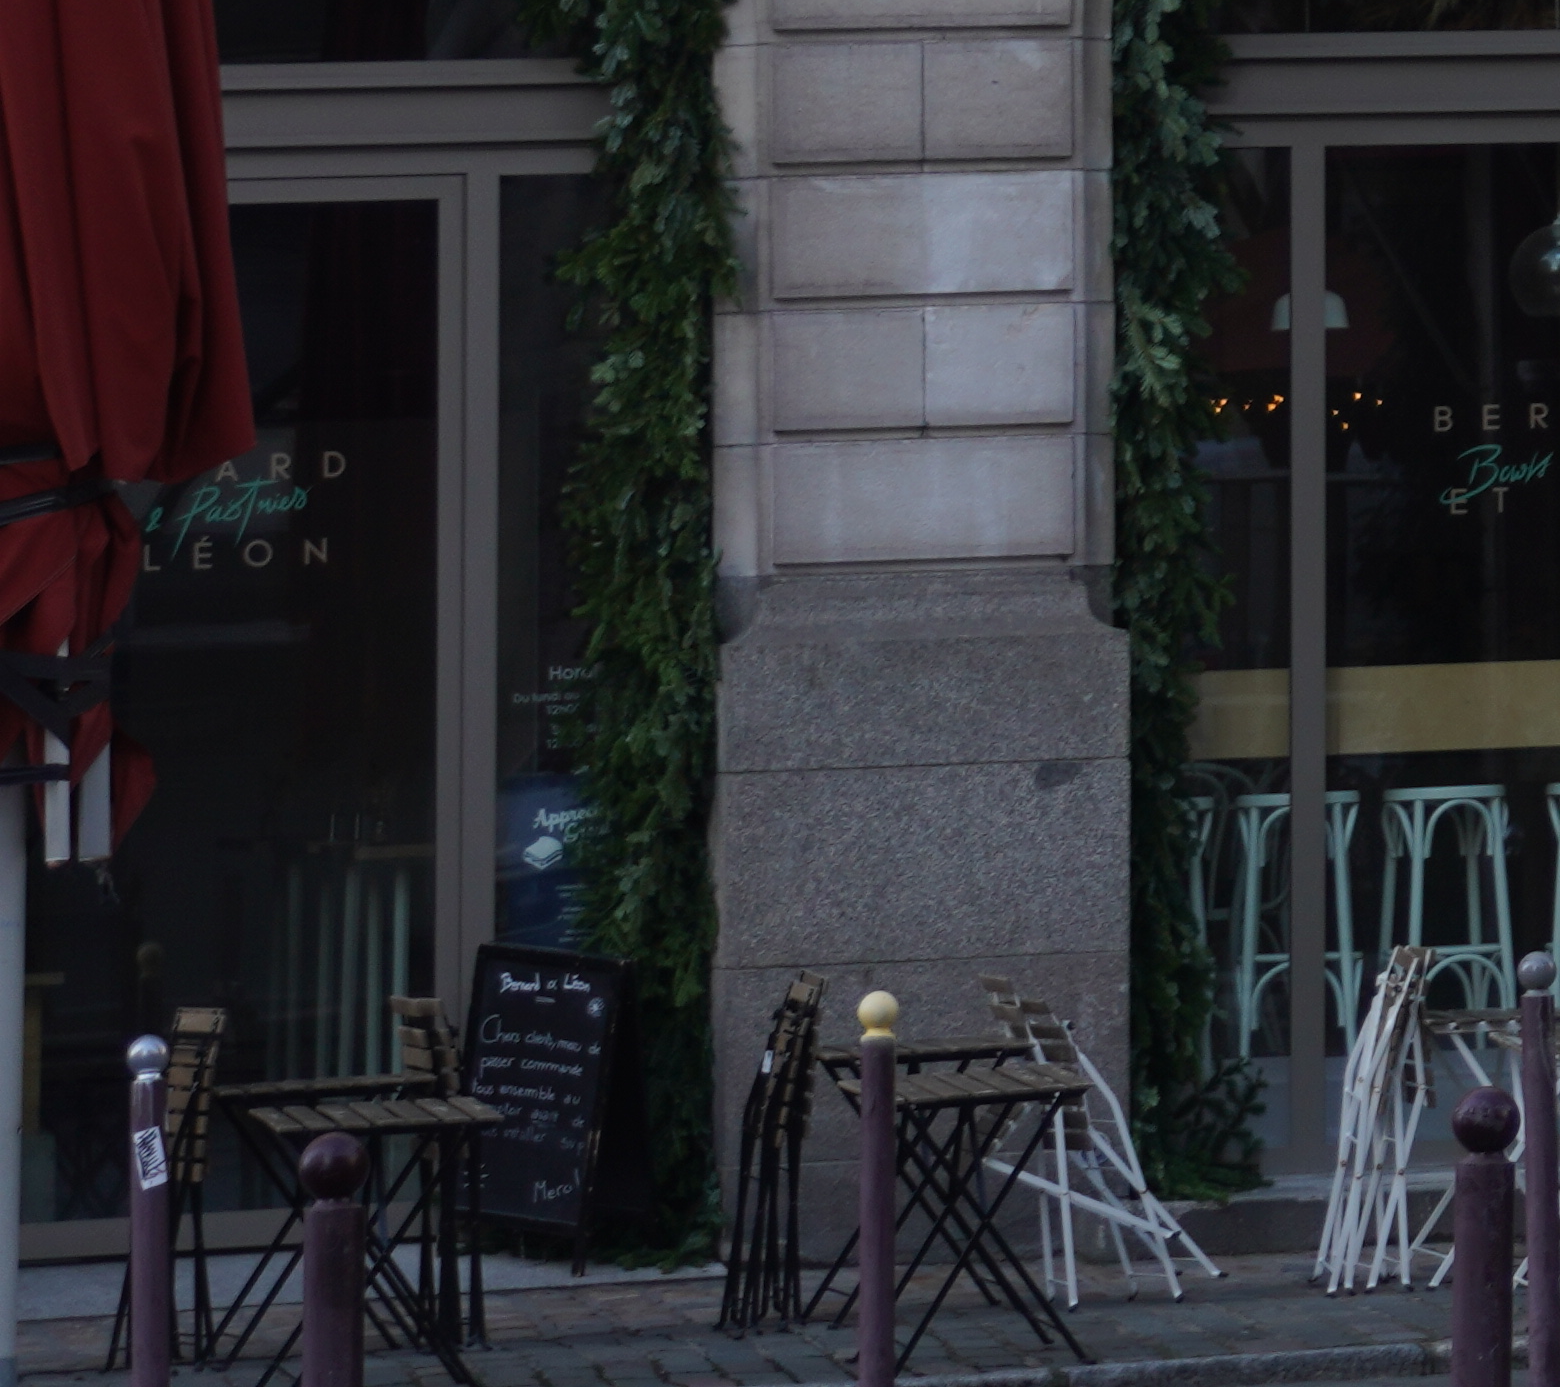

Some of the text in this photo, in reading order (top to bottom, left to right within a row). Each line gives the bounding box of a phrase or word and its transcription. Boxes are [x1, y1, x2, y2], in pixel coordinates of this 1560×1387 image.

[1439, 444, 1553, 506] Bowls
[170, 477, 313, 563] Pastries
[1450, 486, 1510, 515] ET
[143, 535, 328, 572] LÉON
